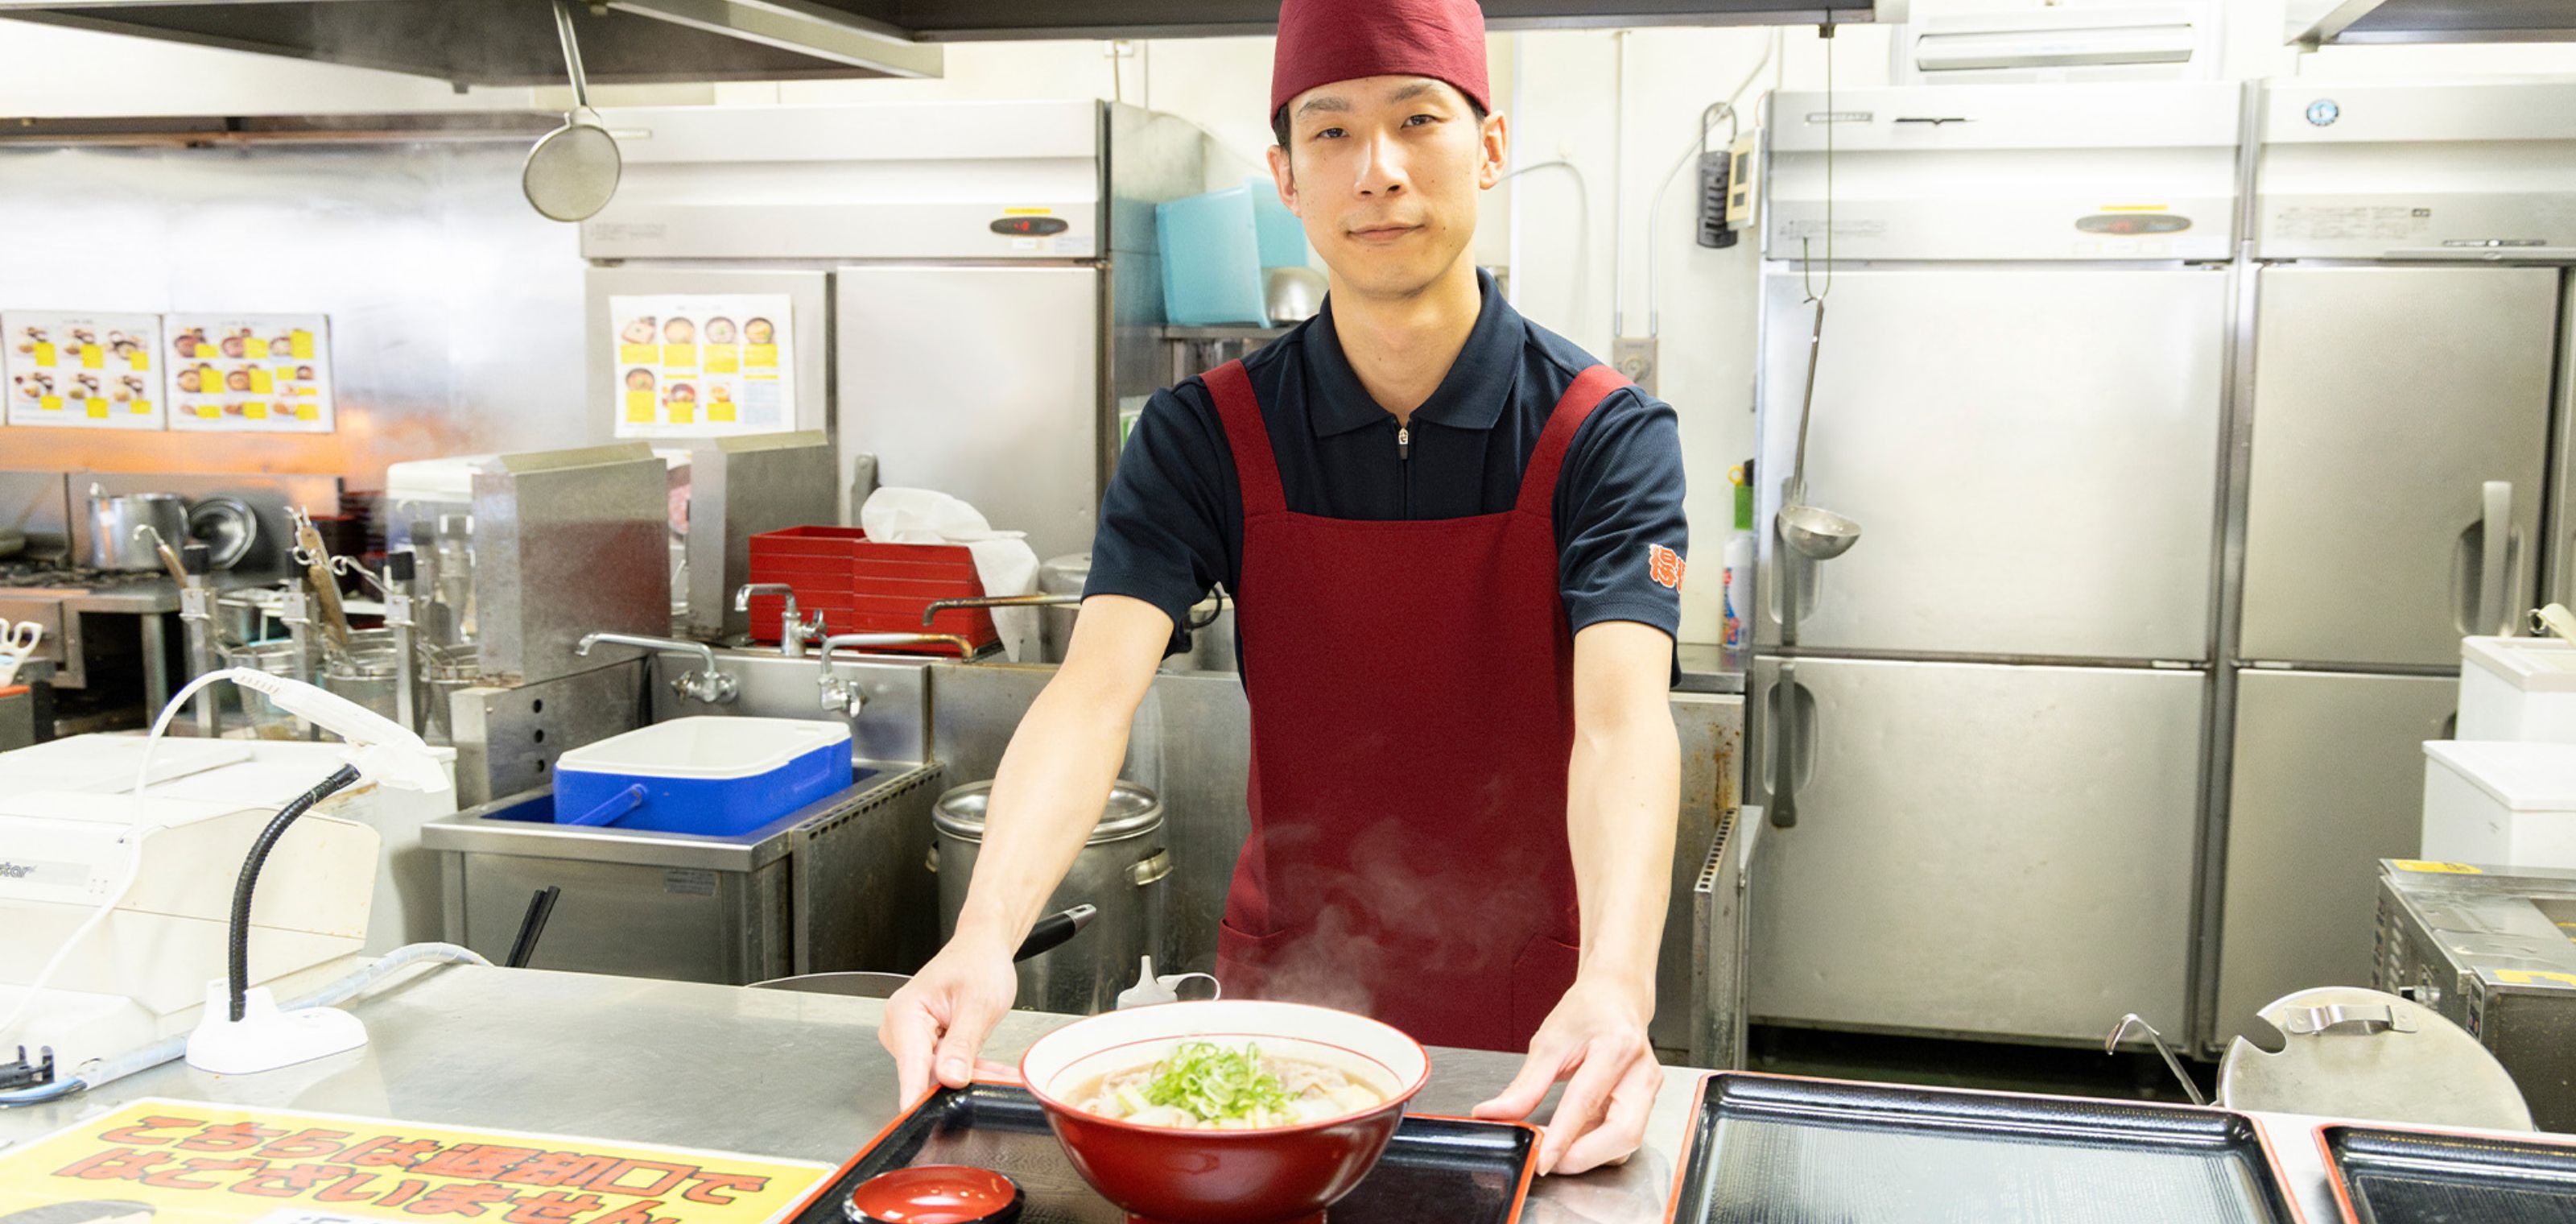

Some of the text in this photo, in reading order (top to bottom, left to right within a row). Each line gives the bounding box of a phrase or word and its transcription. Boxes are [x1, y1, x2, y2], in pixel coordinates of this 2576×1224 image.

[50, 1148, 681, 1224] はございません
[98, 1115, 772, 1205] こちらは返却口で
